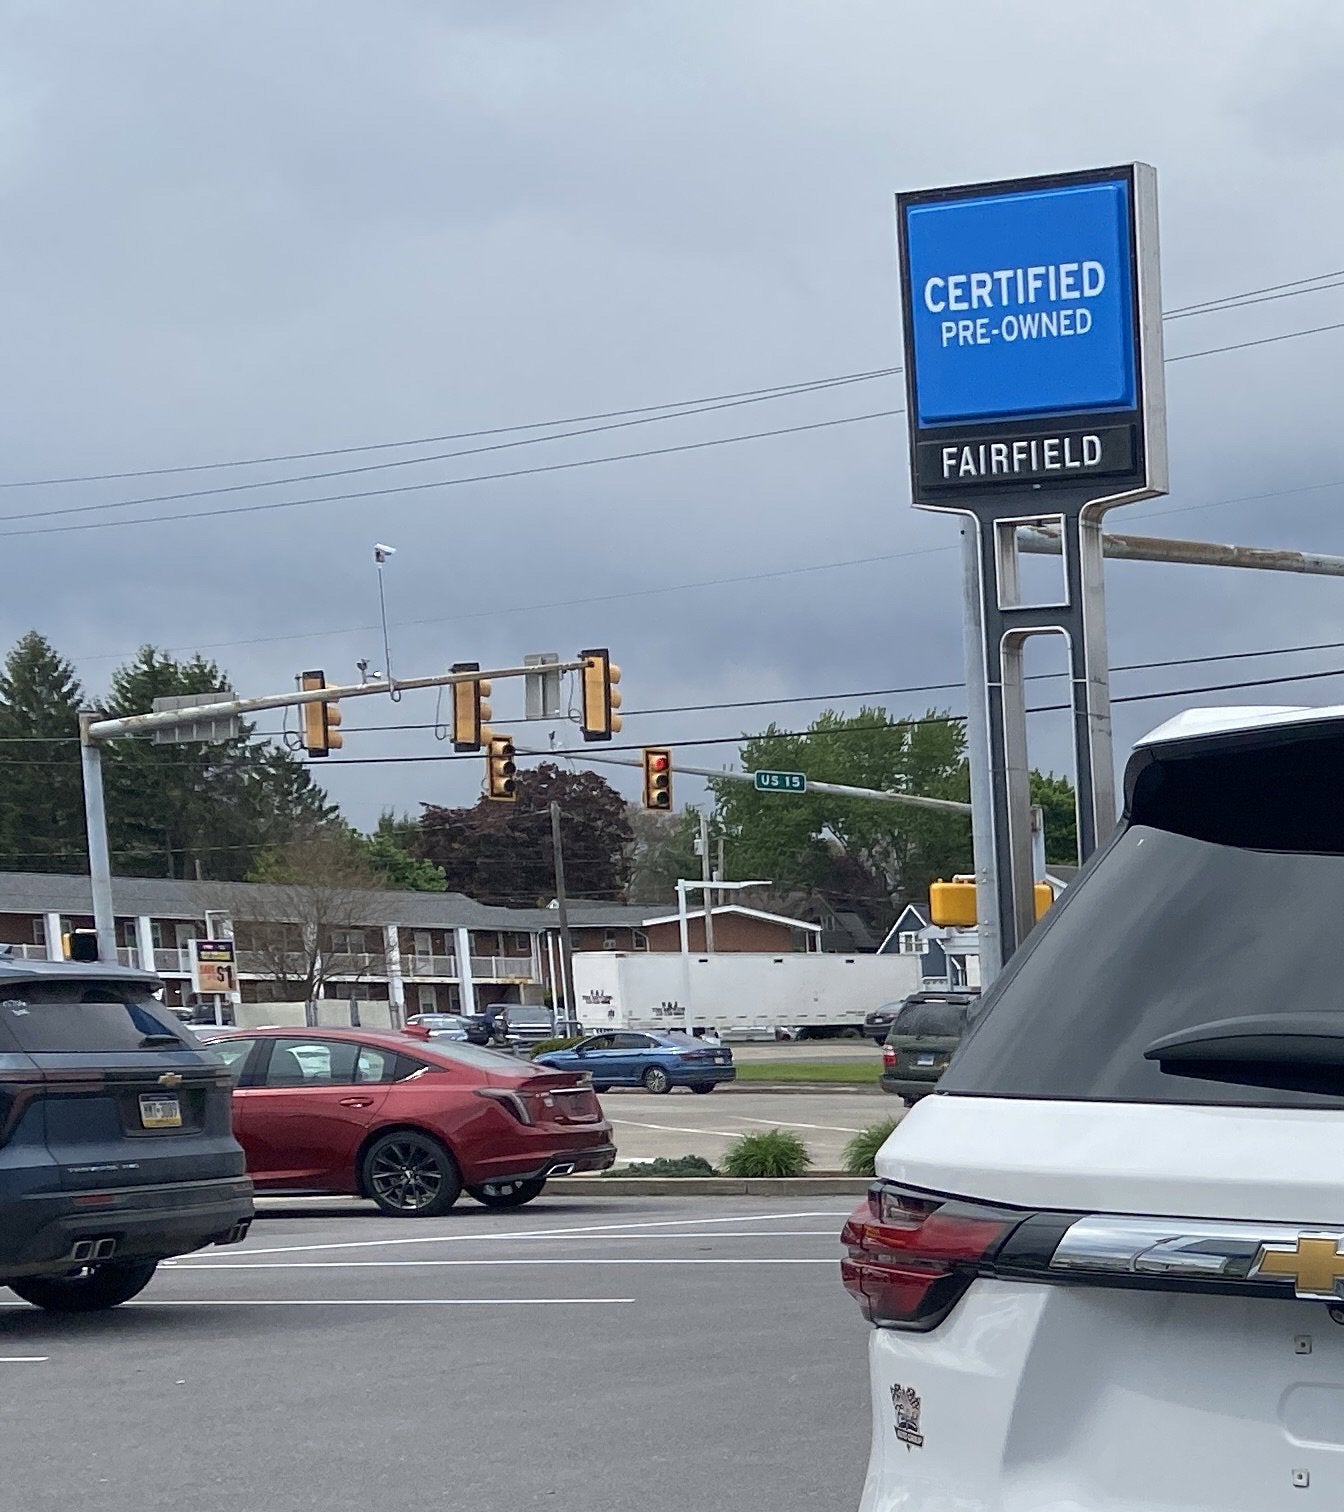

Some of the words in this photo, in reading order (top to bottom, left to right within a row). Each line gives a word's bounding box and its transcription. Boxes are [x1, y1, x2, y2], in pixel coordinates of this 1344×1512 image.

[924, 261, 1106, 313] CERTIFIED
[941, 308, 1093, 348] PRE-OWNED
[942, 435, 1102, 479] FAIRFIELD
[761, 774, 779, 786] US
[785, 776, 800, 787] 15
